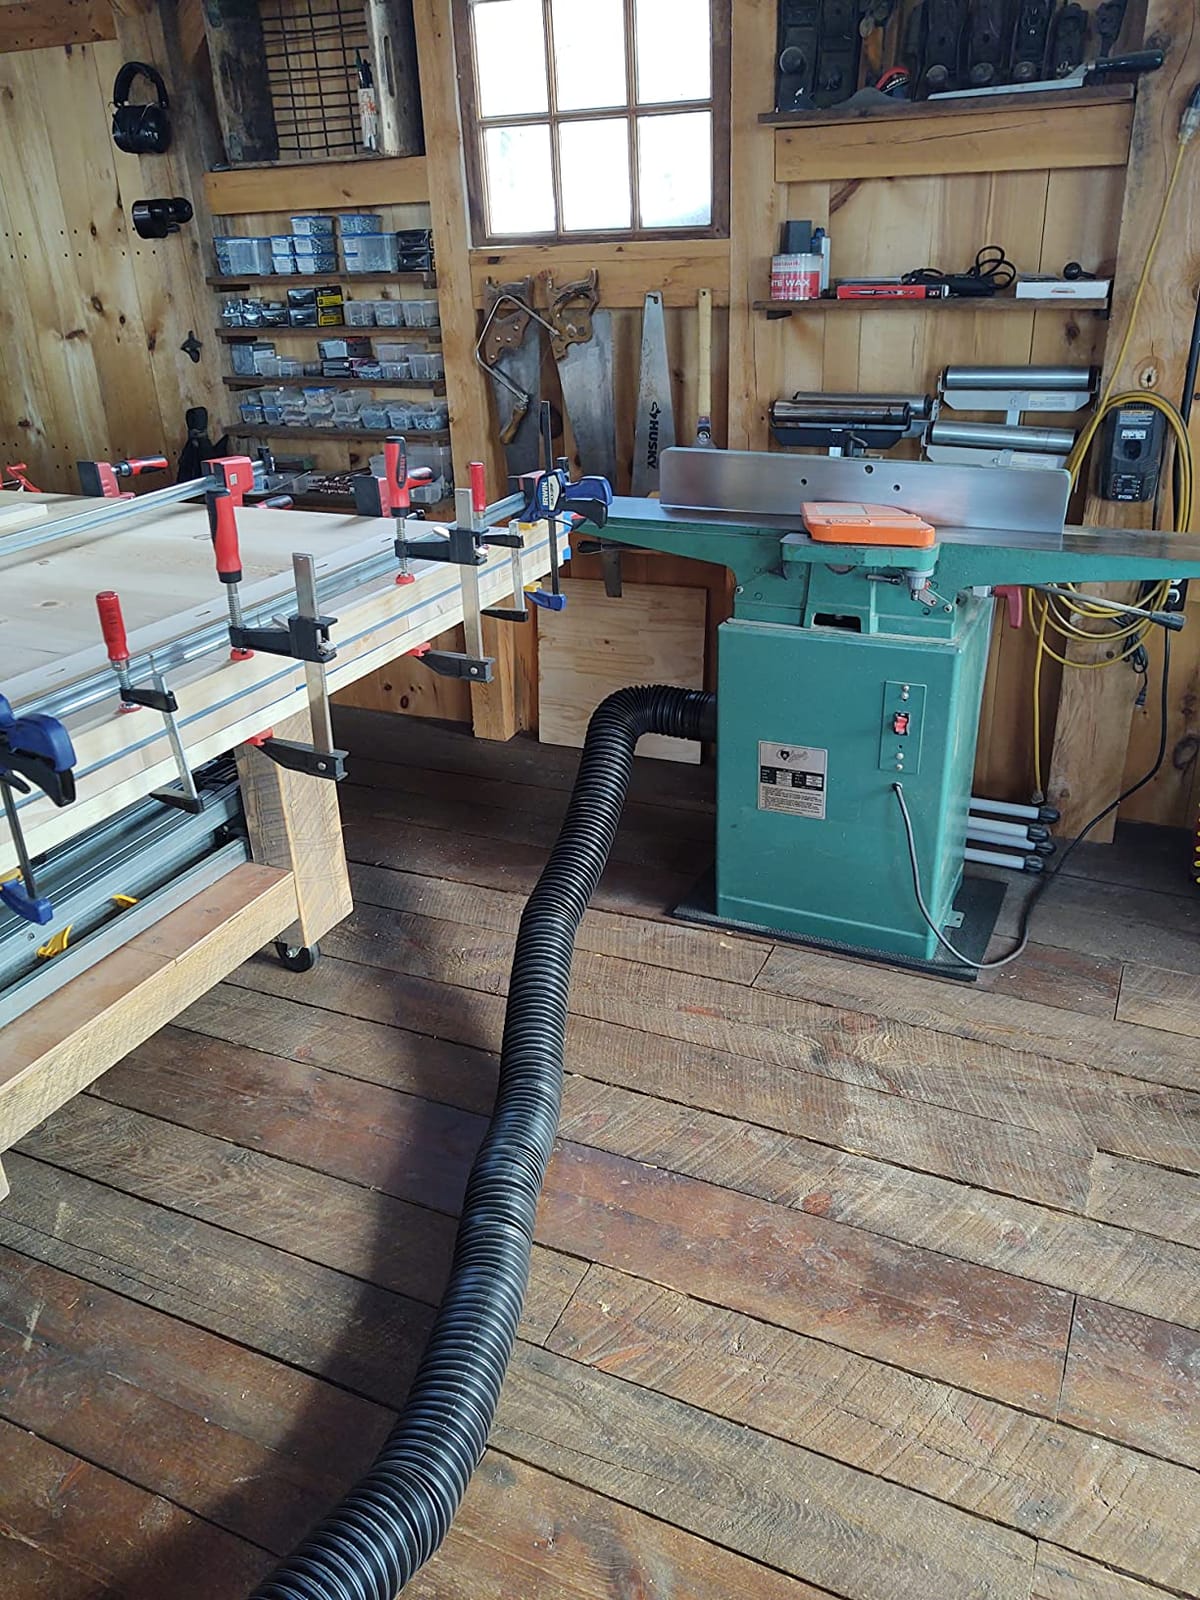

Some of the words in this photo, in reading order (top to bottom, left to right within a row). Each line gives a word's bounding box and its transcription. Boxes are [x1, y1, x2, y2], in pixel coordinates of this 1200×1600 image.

[785, 279, 811, 287] WAX
[647, 420, 659, 469] HUSKY
[541, 481, 549, 506] IRWIN
